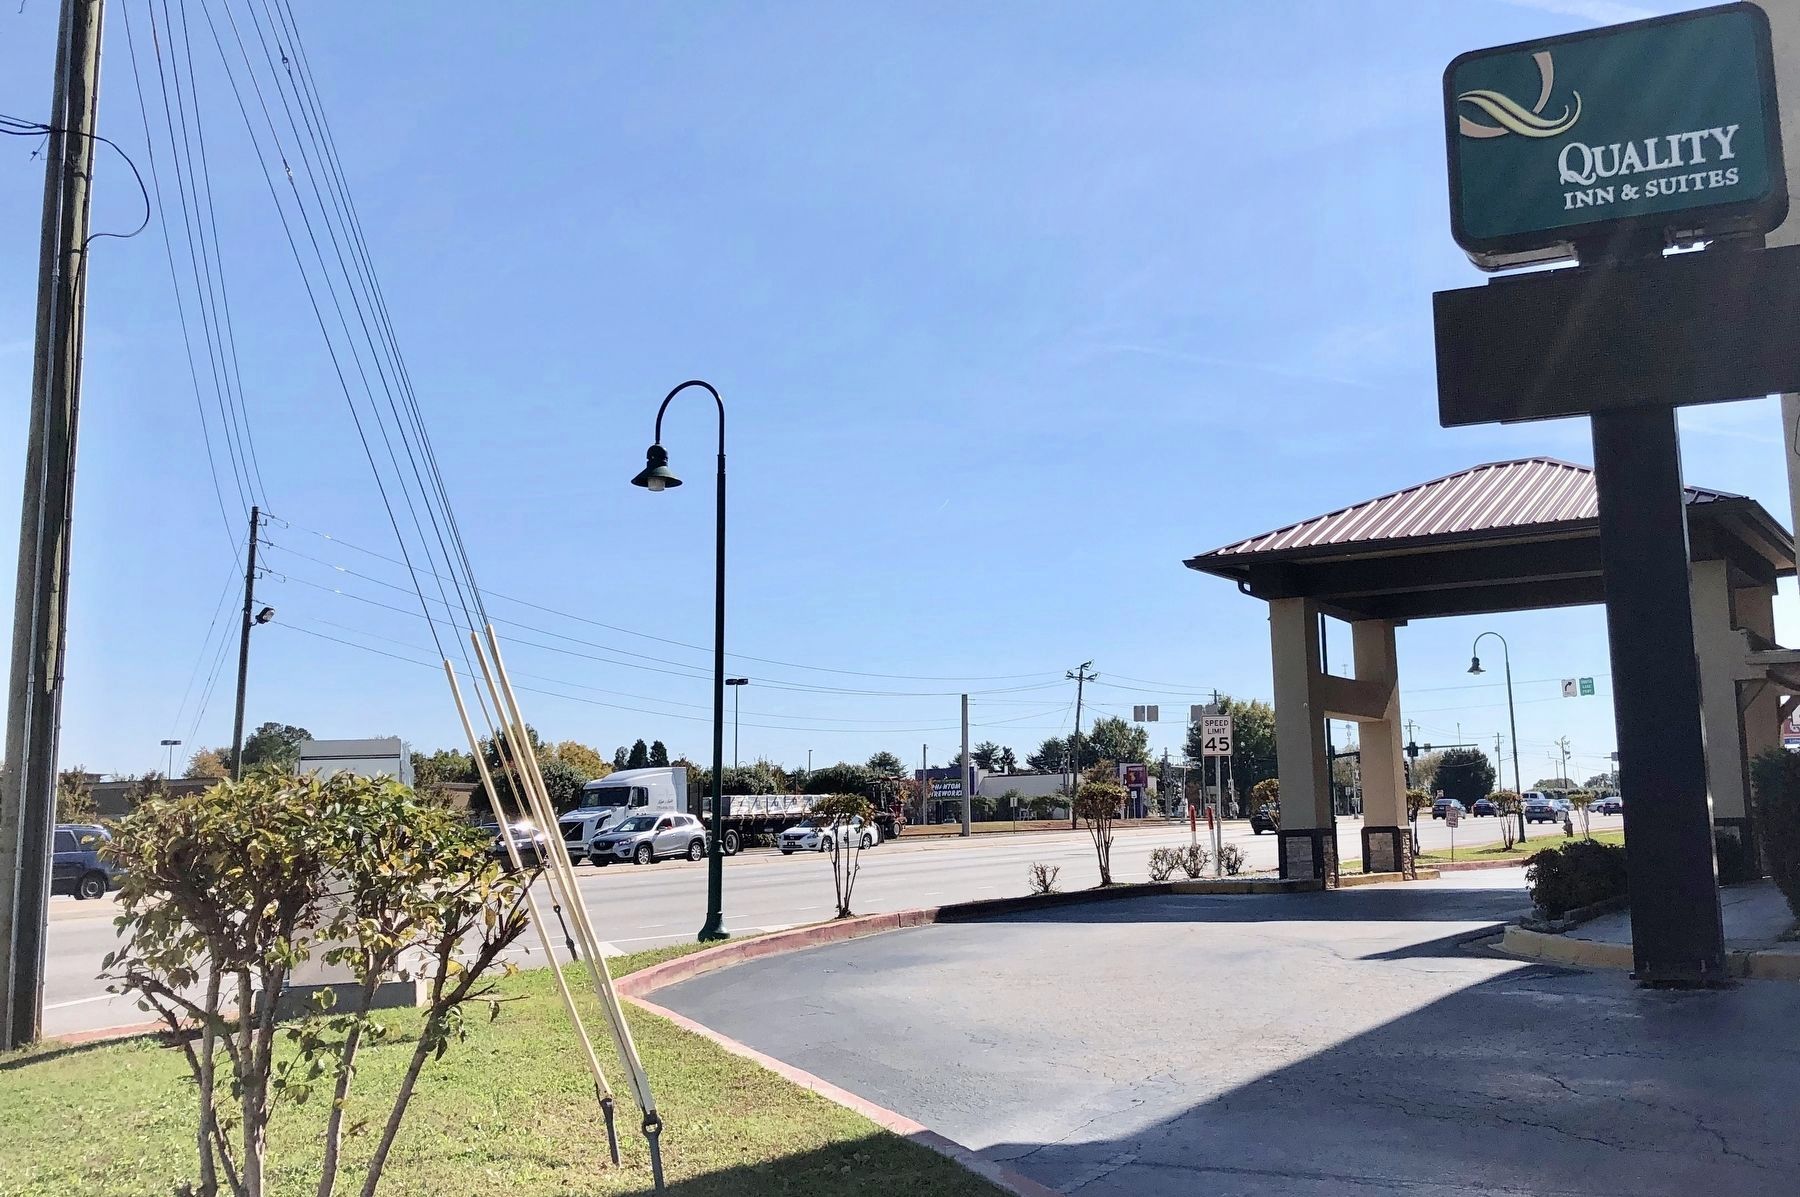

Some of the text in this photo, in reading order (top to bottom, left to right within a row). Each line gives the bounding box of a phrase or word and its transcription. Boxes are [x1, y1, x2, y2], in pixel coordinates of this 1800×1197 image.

[1558, 124, 1739, 185] QUALITY
[1564, 168, 1739, 210] INN & SUITES
[1204, 737, 1229, 751] 45
